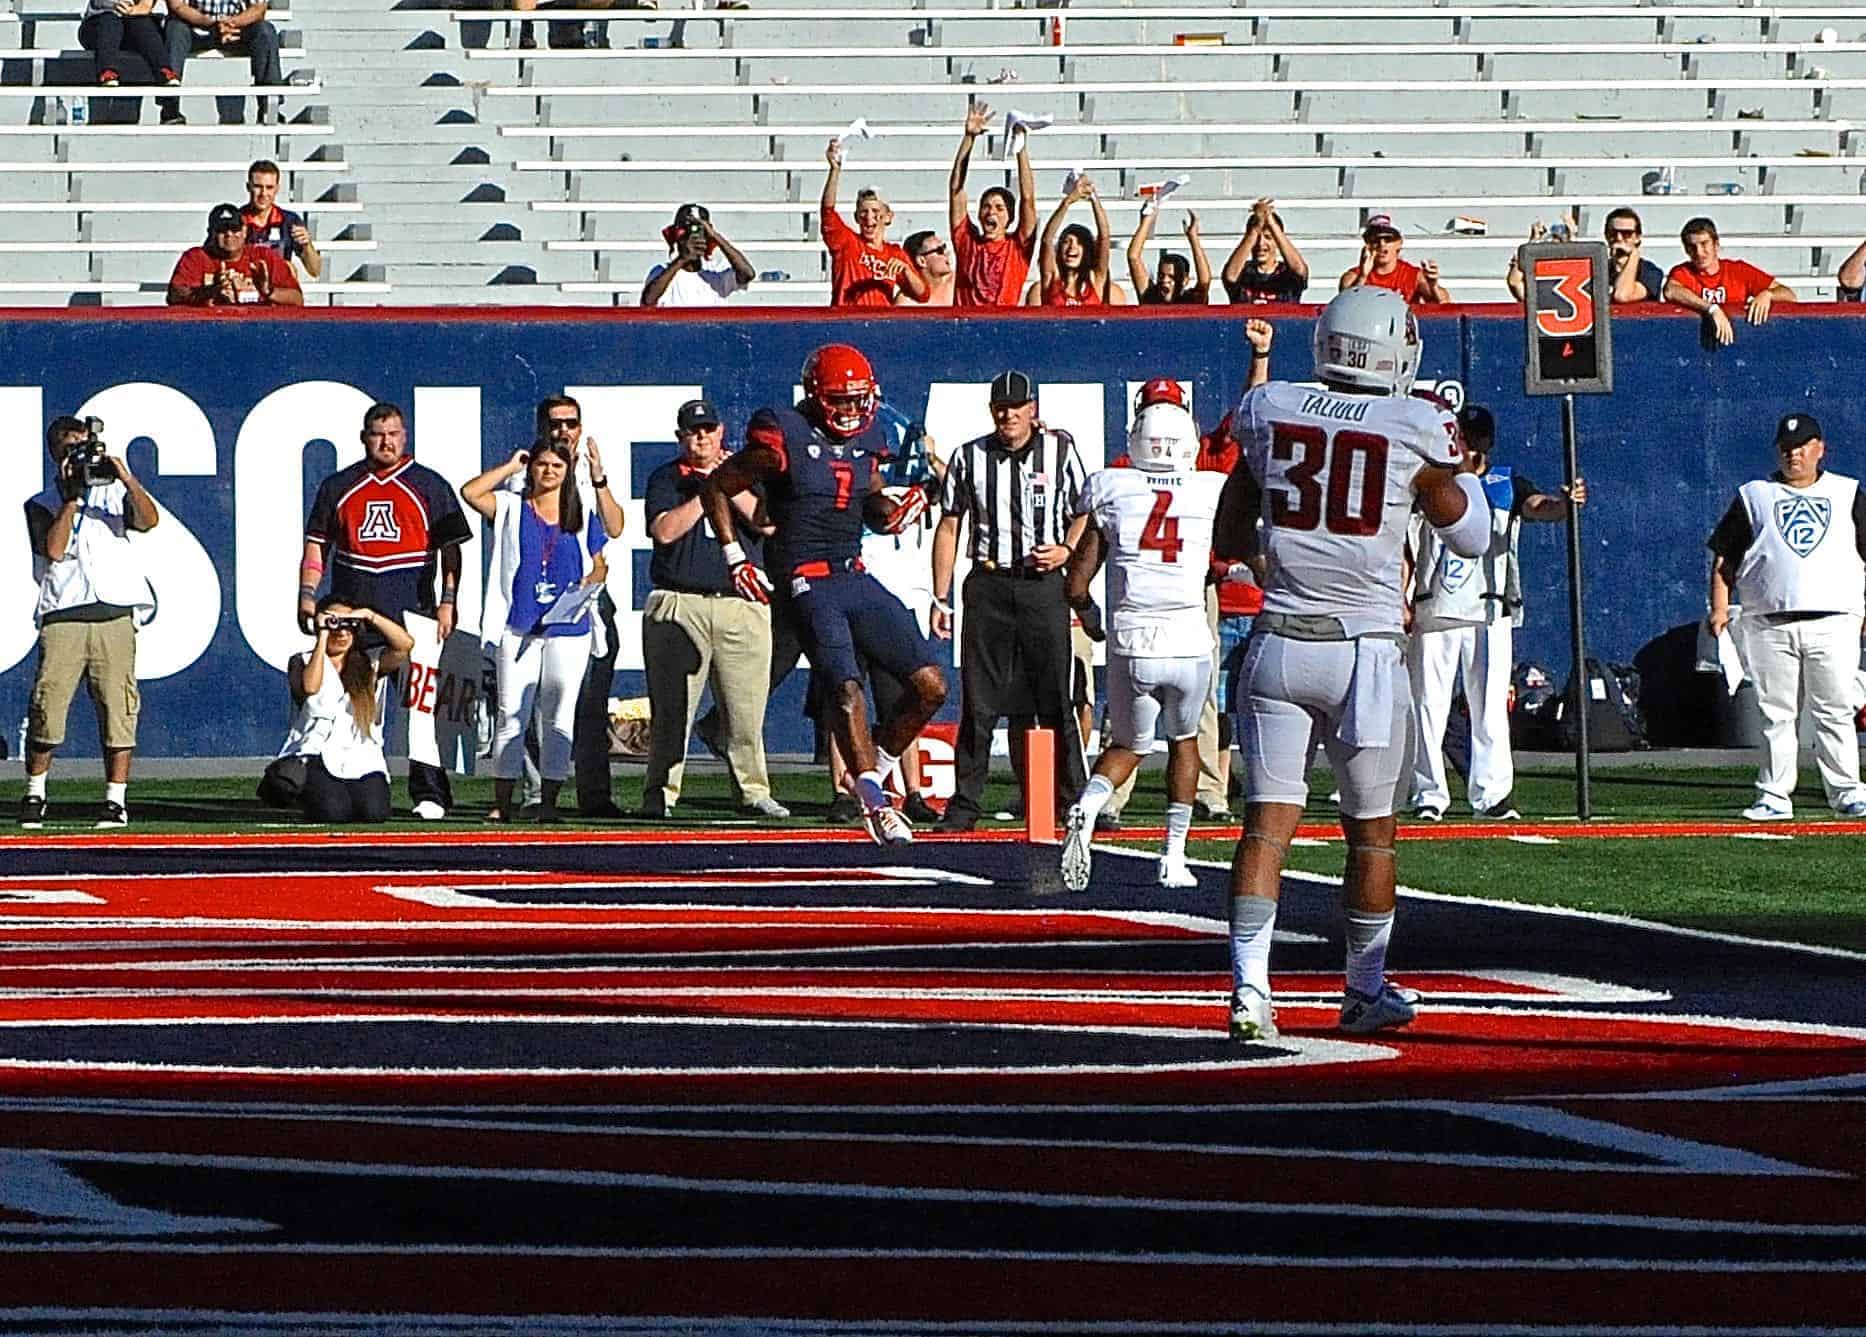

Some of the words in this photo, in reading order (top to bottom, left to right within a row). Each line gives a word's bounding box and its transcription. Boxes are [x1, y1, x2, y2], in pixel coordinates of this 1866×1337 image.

[1535, 259, 1593, 337] 3
[1347, 351, 1367, 369] 30
[1301, 394, 1369, 422] TALIULU
[1268, 421, 1390, 537] 30
[358, 501, 401, 542] A
[1138, 489, 1184, 564] 4
[1793, 527, 1815, 545] 12
[1443, 559, 1465, 579] 12
